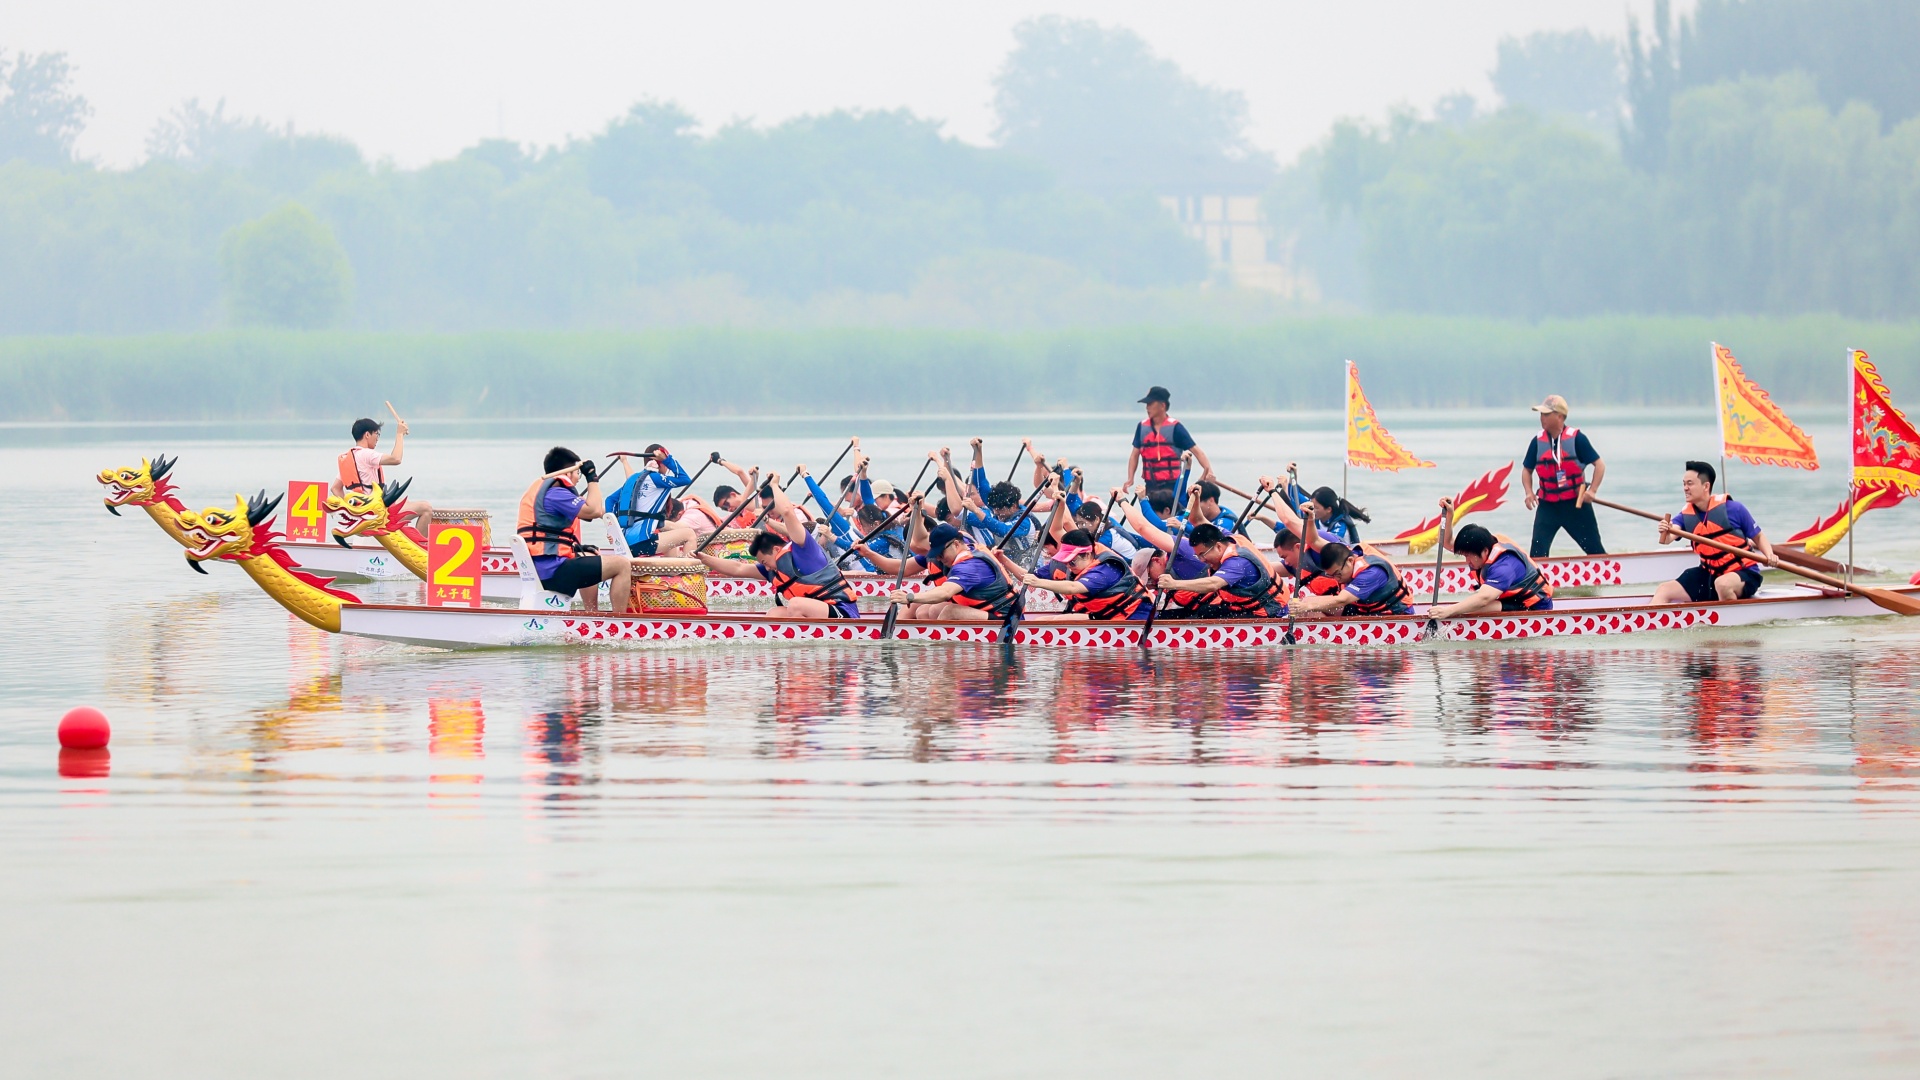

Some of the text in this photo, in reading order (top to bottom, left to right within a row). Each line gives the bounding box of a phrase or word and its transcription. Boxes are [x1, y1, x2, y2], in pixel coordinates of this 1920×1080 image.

[291, 484, 323, 527] 4
[292, 527, 319, 537] 九子龍
[433, 527, 475, 586] 2
[436, 587, 472, 600] 九子龍
